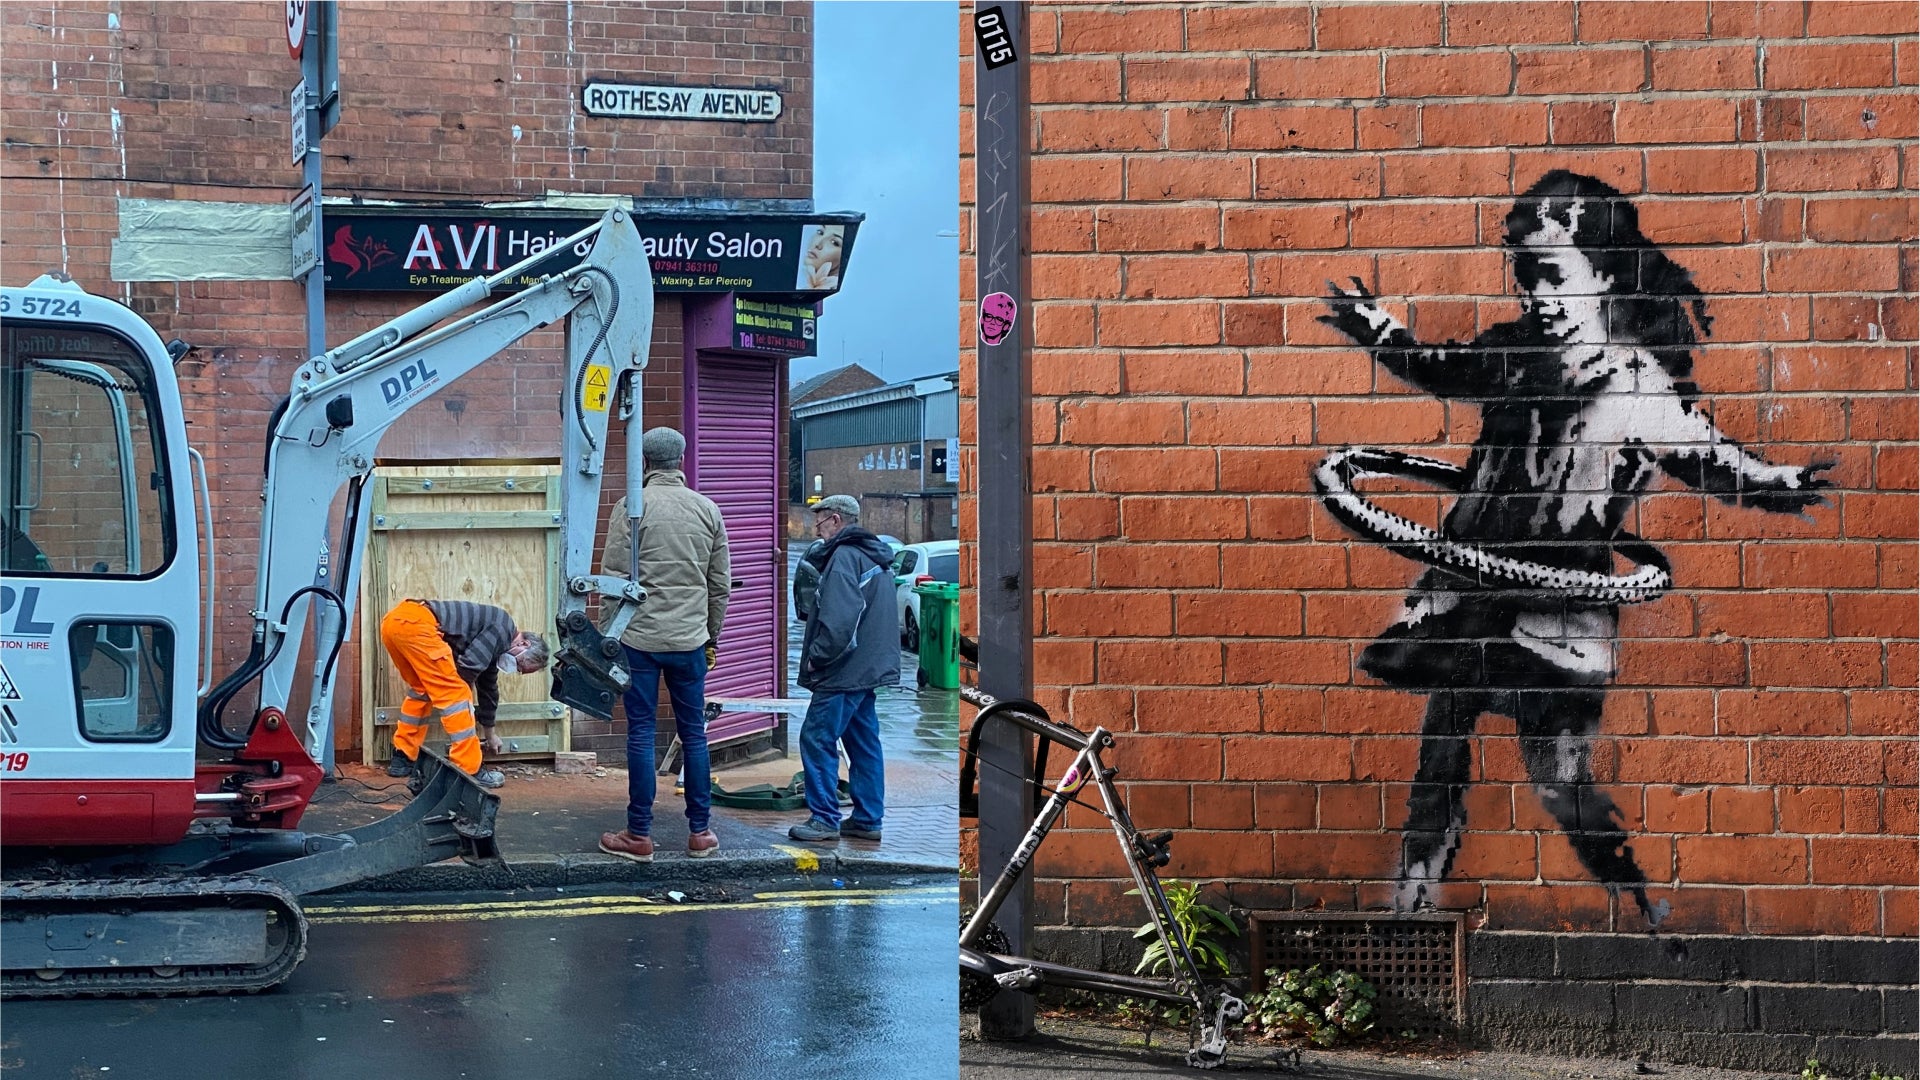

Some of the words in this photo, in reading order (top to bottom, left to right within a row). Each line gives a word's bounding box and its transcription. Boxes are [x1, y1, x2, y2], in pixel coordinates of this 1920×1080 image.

[978, 13, 1013, 63] 0115
[591, 88, 692, 113] ROTHESAY
[700, 93, 775, 116] AVENUE
[706, 231, 782, 258] Salon
[654, 260, 683, 272] 07941
[684, 261, 718, 274] 363110
[409, 275, 428, 286] Eye
[698, 276, 713, 286] Ear
[715, 276, 753, 288] Piercing
[22, 296, 82, 318] 5724
[380, 358, 438, 404] DPL
[27, 641, 50, 650] HIRE
